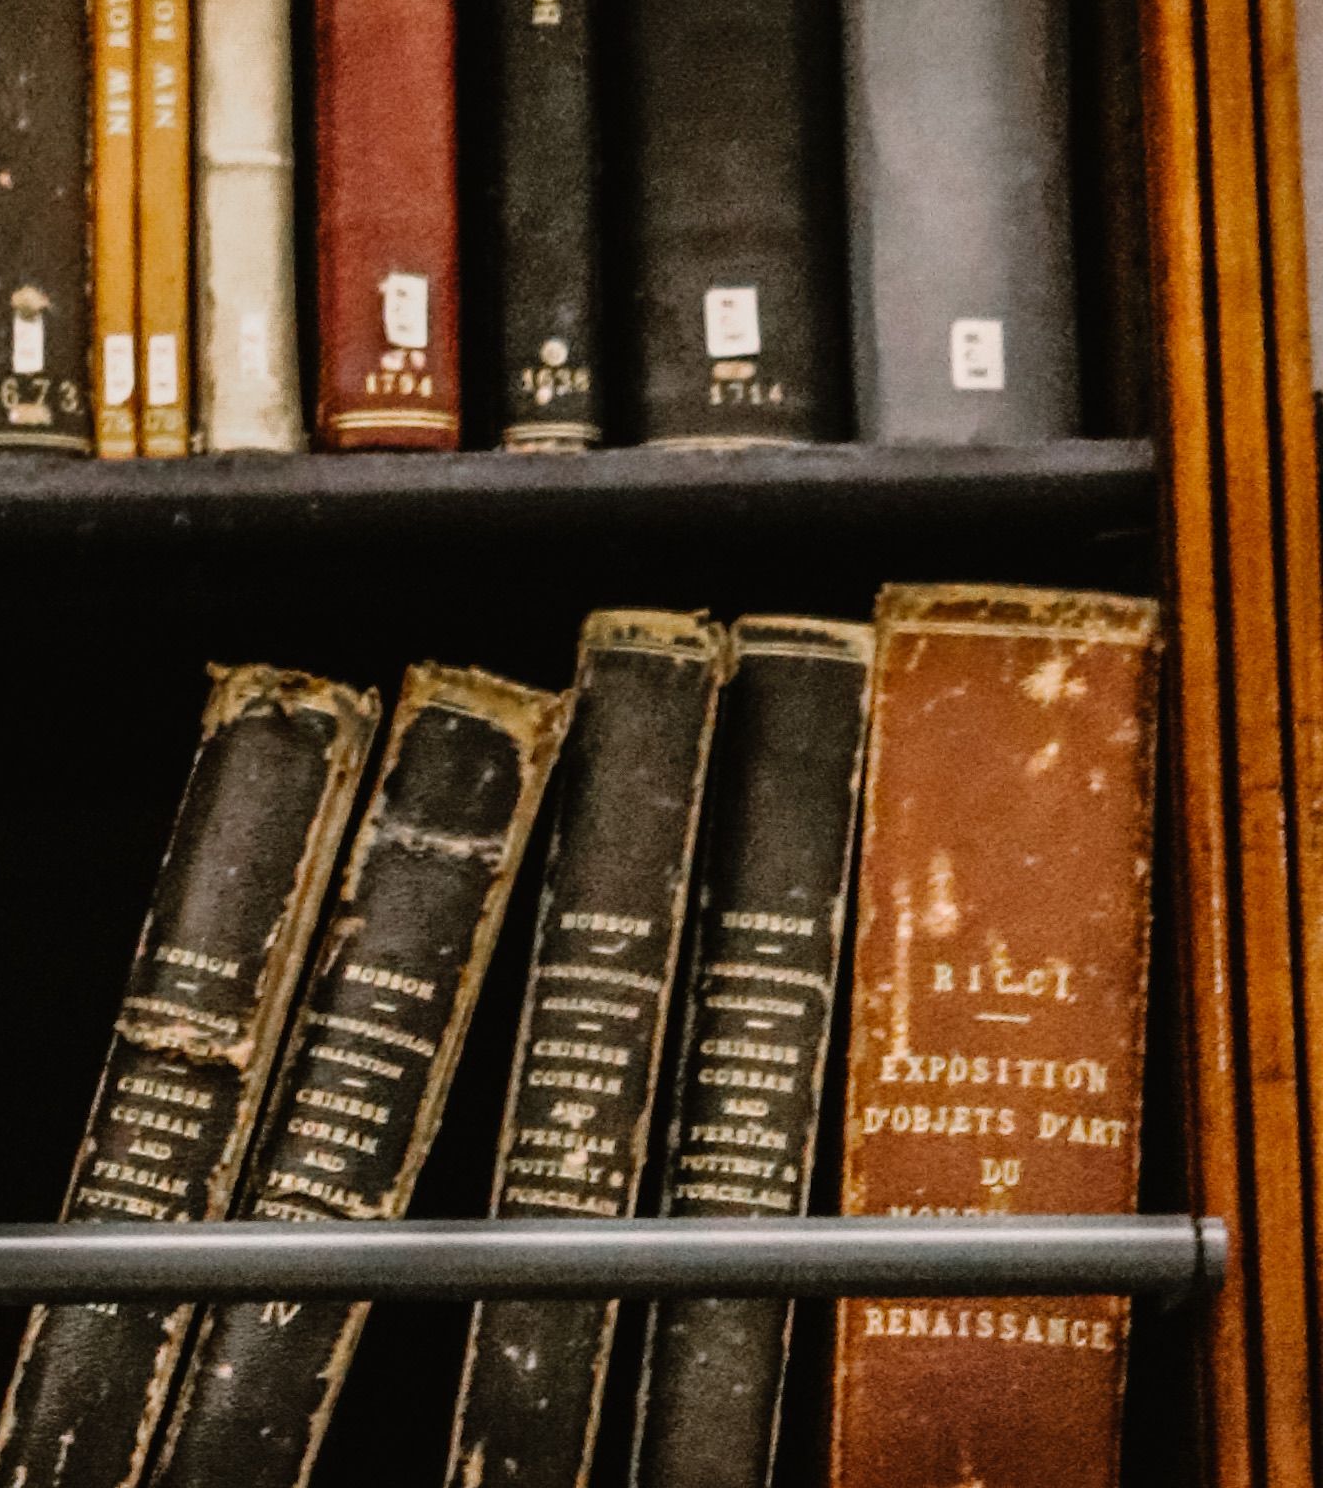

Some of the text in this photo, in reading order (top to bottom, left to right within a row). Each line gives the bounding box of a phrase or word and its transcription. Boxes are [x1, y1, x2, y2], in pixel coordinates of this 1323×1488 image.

[880, 1056, 1109, 1094] EXPOSITION
[864, 1109, 1126, 1148] D'OBJETS D'ART
[981, 1159, 1022, 1187] DU
